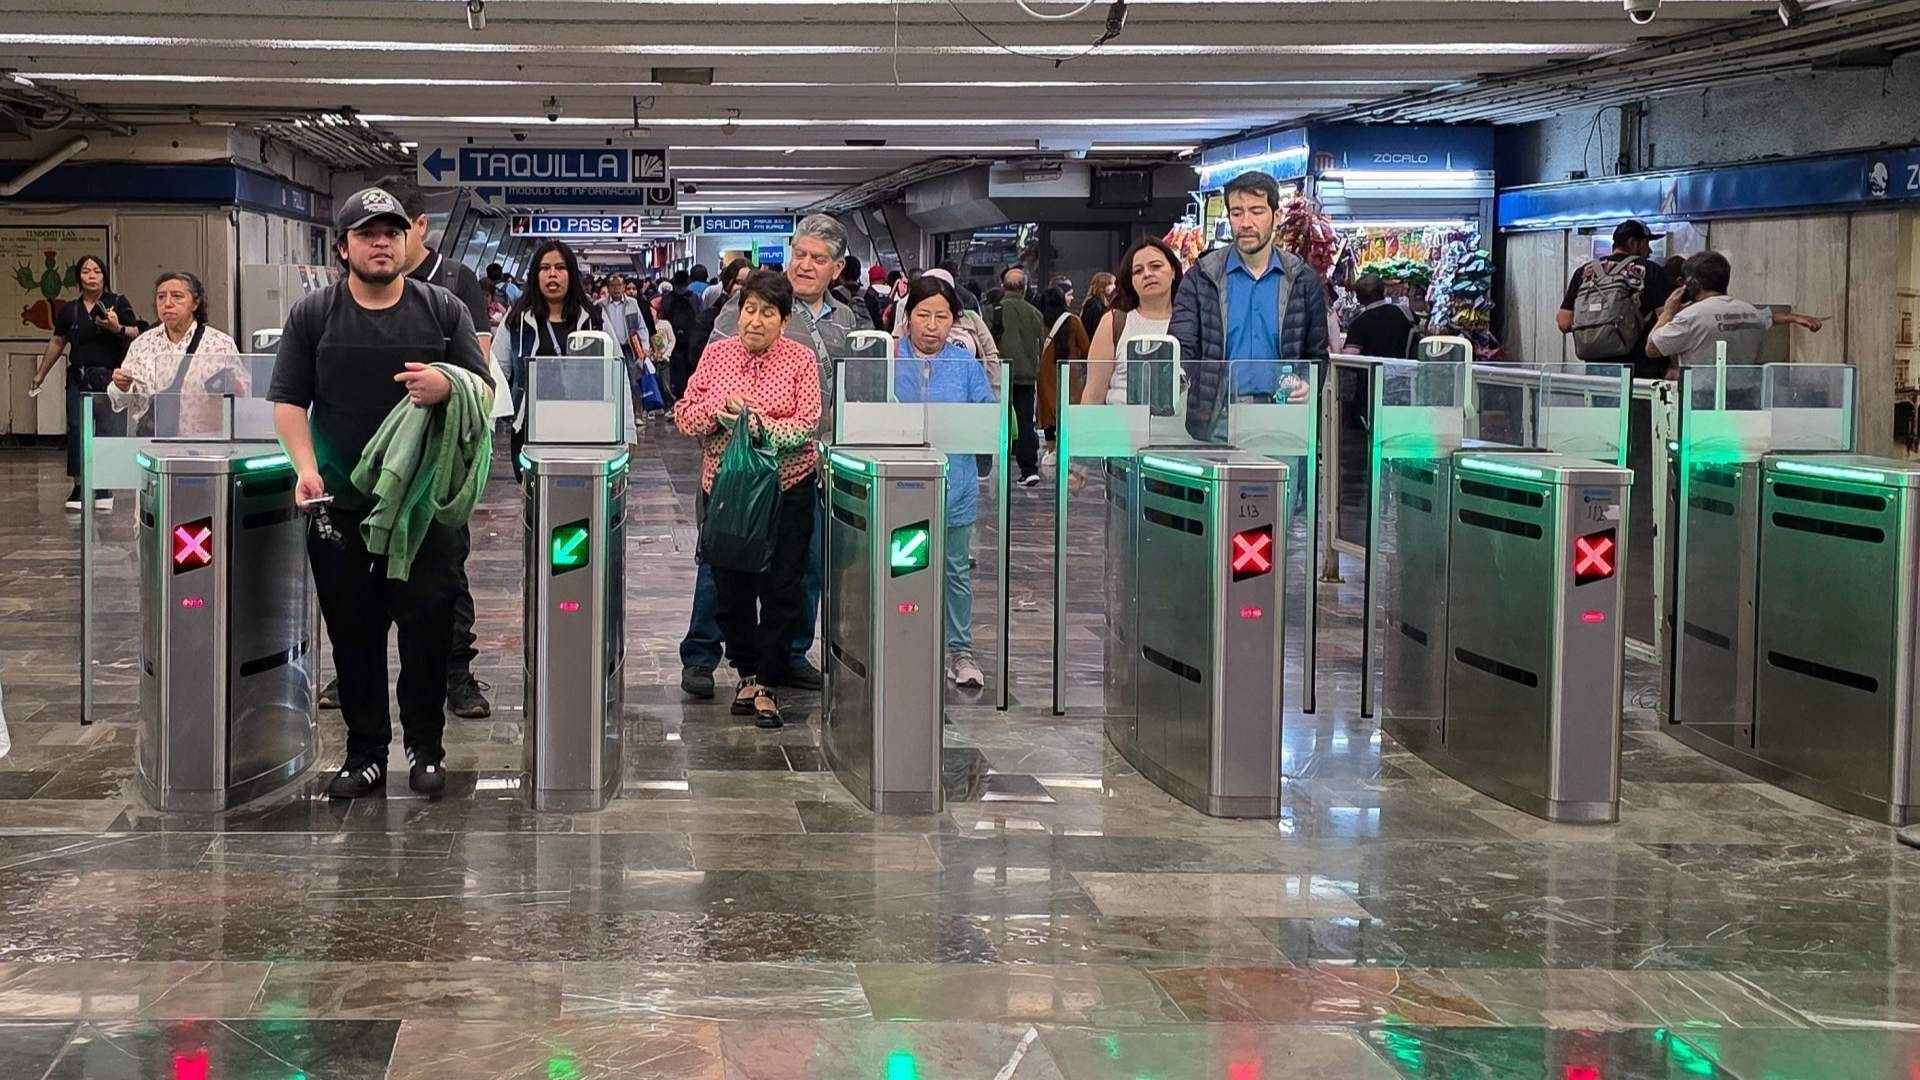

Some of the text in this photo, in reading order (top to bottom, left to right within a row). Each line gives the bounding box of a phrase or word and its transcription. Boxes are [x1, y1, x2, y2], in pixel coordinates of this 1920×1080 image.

[470, 153, 619, 178] TAQUILLA
[538, 219, 614, 232] NO PASE
[706, 218, 750, 230] SALIDA
[1239, 504, 1260, 518] 113
